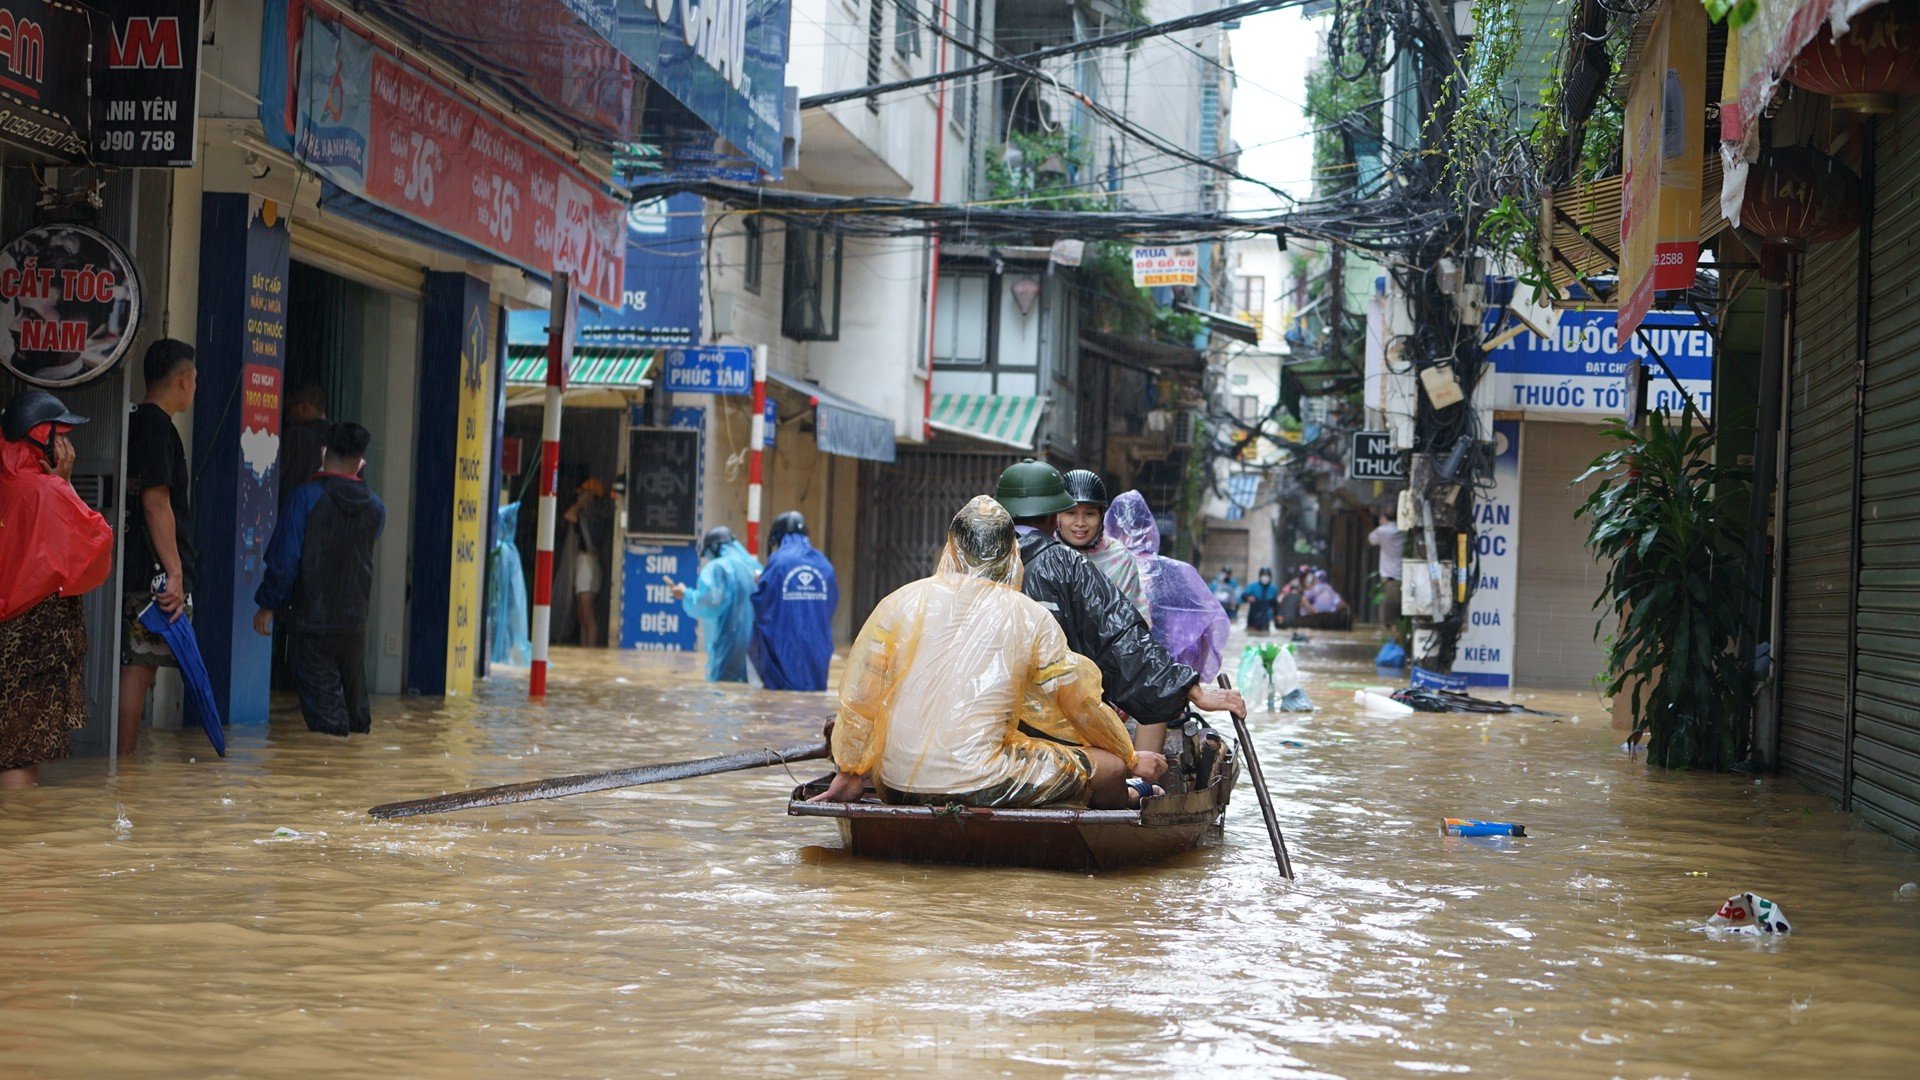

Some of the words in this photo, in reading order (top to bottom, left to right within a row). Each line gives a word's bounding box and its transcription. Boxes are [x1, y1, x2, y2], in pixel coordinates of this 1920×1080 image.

[106, 101, 135, 120] NH
[142, 97, 177, 120] YÊN
[140, 131, 175, 151] 758
[531, 166, 555, 210] HỒNG
[1136, 248, 1167, 259] MUA
[0, 256, 56, 299] CẮT
[61, 263, 116, 303] TÓC
[252, 272, 264, 290] BẤT
[264, 276, 282, 294] CHẤP
[250, 292, 268, 311] NẮNG
[268, 298, 281, 314] MƯA
[20, 320, 88, 353] NAM
[263, 320, 283, 340] THUỐC
[252, 337, 264, 357] TẬN
[264, 339, 277, 357] NHÀ
[698, 350, 726, 364] PHỐ
[251, 372, 261, 387] GỌI
[261, 374, 275, 387] NGAY
[671, 365, 711, 386] PHÚC
[716, 365, 746, 387] TÂN
[1586, 362, 1606, 375] ĐẠT
[246, 389, 261, 407] 1800
[262, 392, 278, 410] 6928
[1513, 379, 1585, 407] THUỐC
[465, 408, 477, 441] ĐỦ
[1367, 438, 1397, 455] NH
[459, 450, 480, 481] THUỐC
[457, 491, 477, 520] CHÍNH
[456, 532, 475, 563] HÃNG
[645, 555, 677, 574] SIM
[456, 600, 469, 629] GIÁ
[640, 611, 679, 636] ĐIỆN
[1472, 610, 1501, 627] QUẢ
[454, 638, 468, 669] TỐT
[1464, 645, 1501, 664] KIỆM
